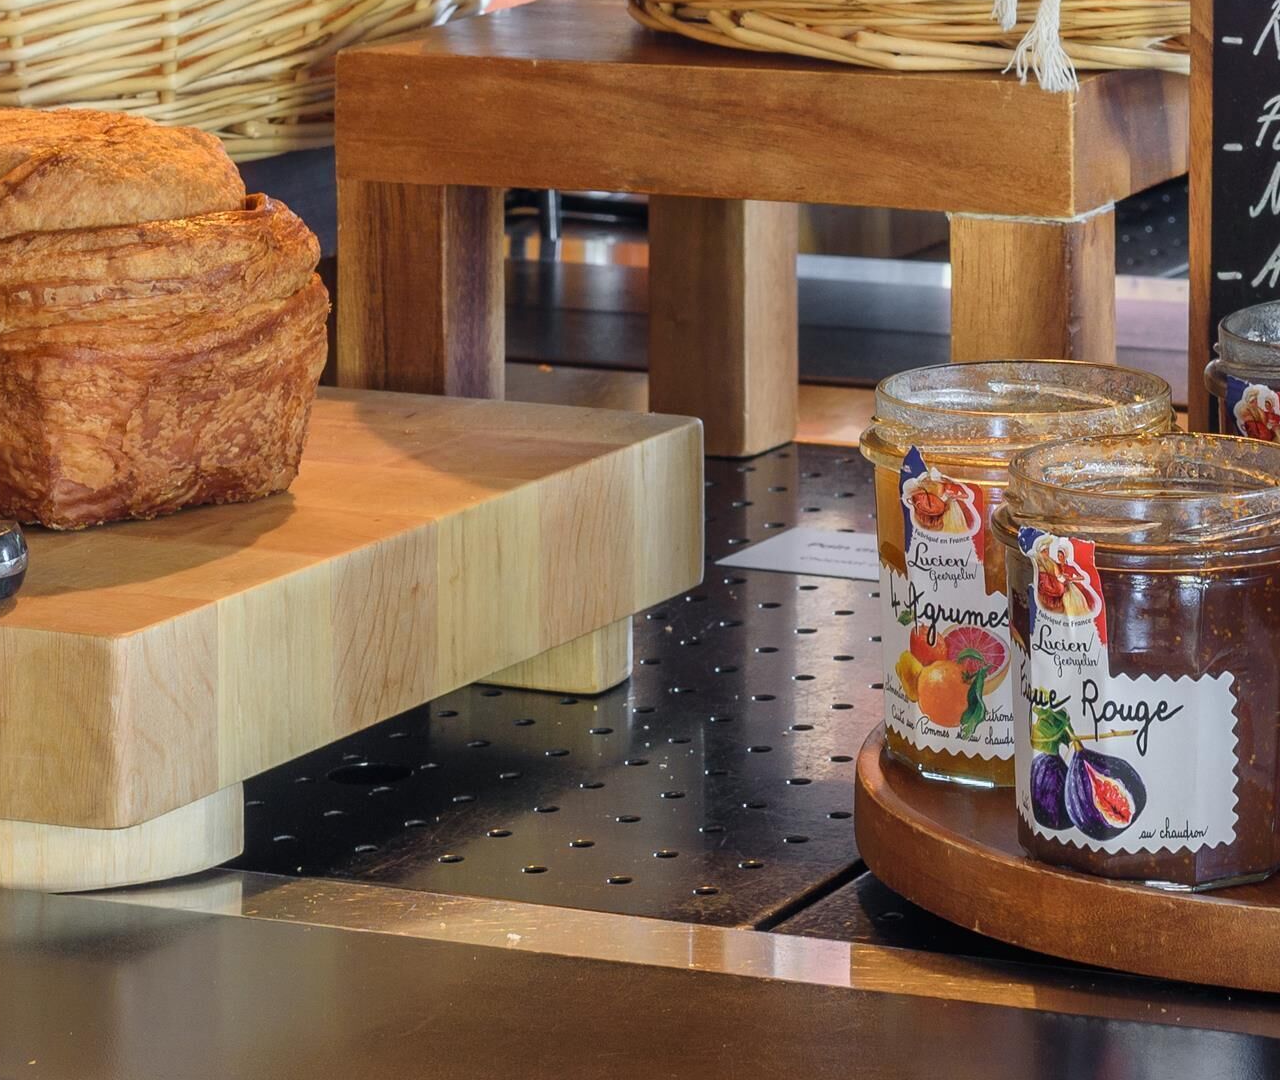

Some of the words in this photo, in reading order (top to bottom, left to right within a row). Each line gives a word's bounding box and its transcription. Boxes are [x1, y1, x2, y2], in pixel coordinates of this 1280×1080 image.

[907, 542, 972, 572] Lucien
[929, 564, 978, 592] Georgelin
[904, 581, 1009, 647] Agrumes
[1032, 624, 1095, 656] Lucien
[1053, 651, 1100, 678] Georgelin
[915, 716, 950, 738] Pommes
[984, 726, 1015, 747] chaudr
[1082, 678, 1184, 756] Rouge
[1138, 828, 1156, 839] au
[1159, 816, 1209, 841] chaudron
